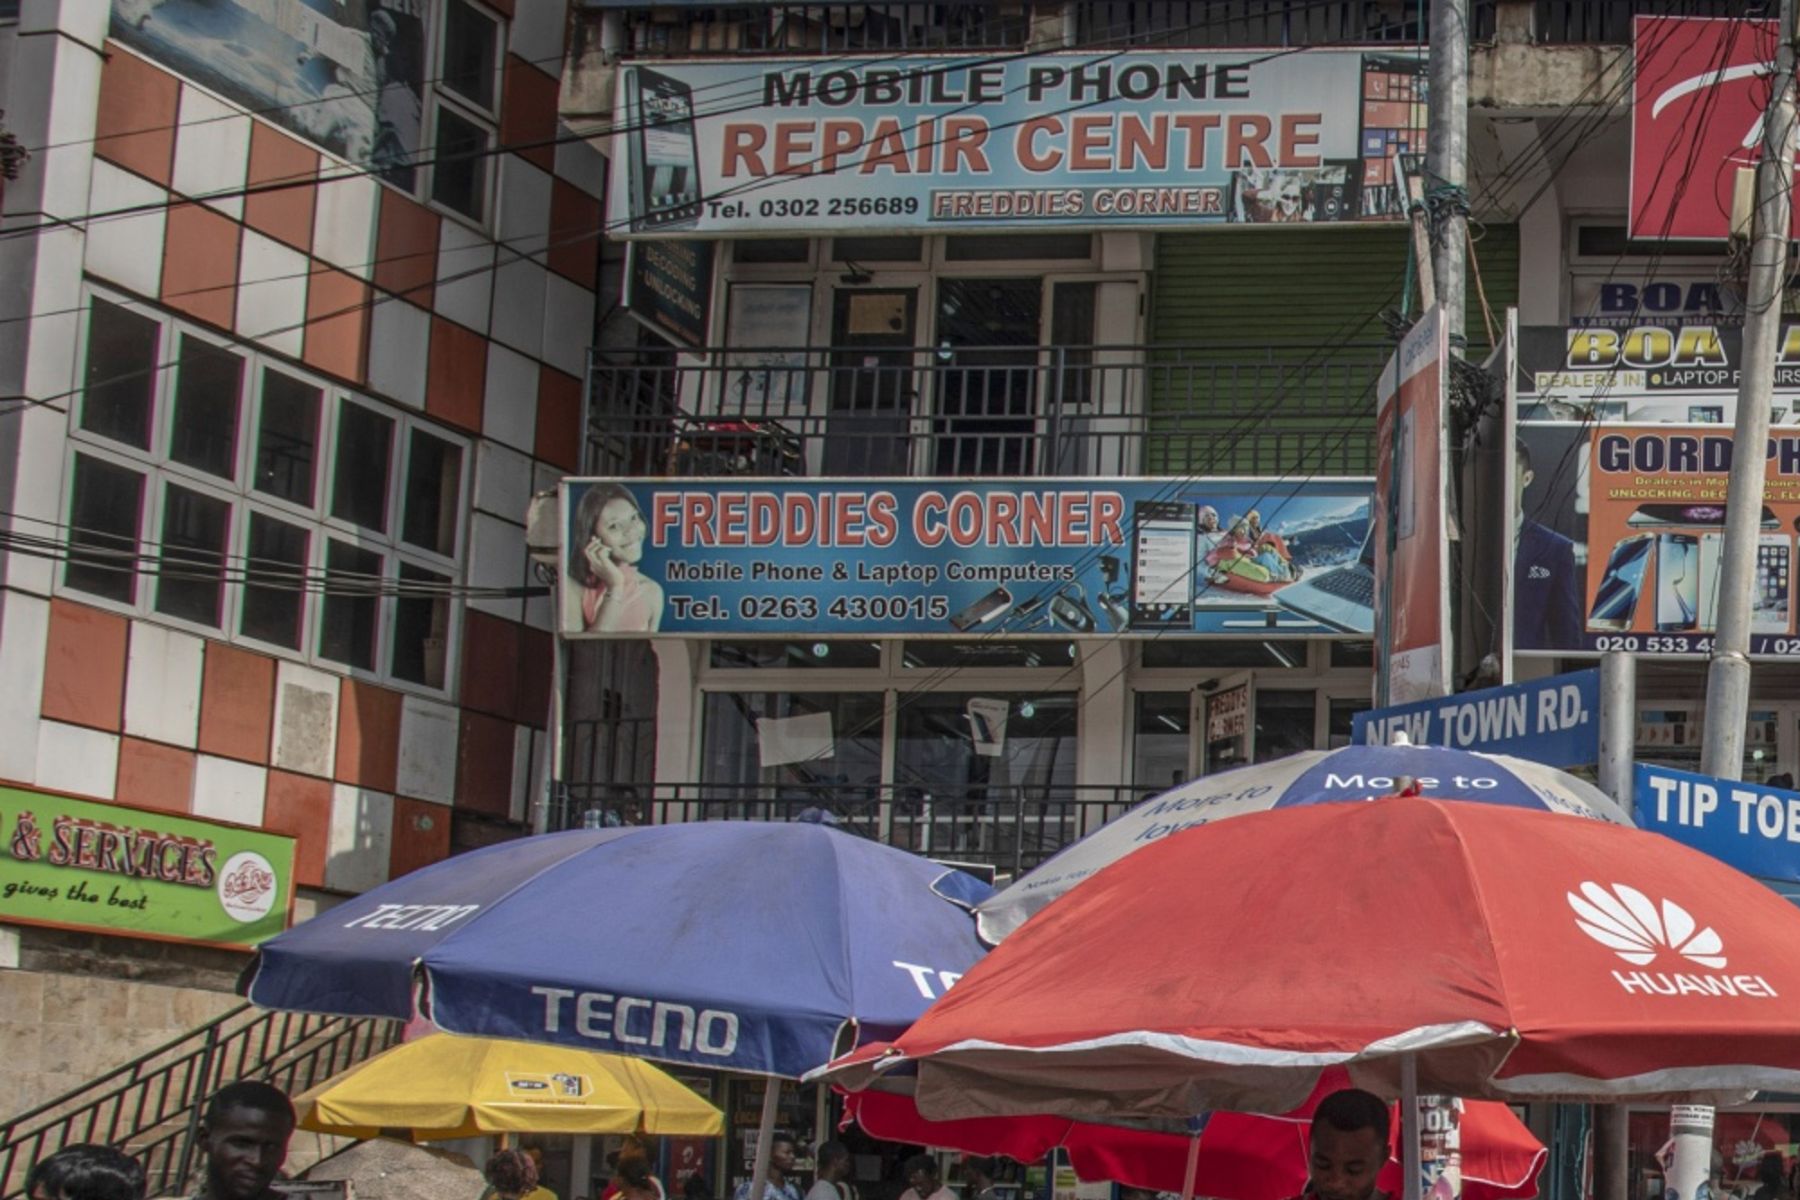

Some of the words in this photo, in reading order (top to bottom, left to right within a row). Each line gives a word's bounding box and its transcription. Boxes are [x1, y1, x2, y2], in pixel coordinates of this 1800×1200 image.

[763, 66, 1004, 107] MOBILE
[1028, 63, 1251, 101] PHONE
[721, 115, 991, 178] REPAIR
[1015, 112, 1323, 172] CENTRE
[708, 201, 750, 219] Tel.
[759, 199, 819, 217] 0302
[827, 196, 918, 216] 256689
[934, 189, 1084, 218] FREDDIES
[1091, 187, 1224, 215] CORNER
[642, 248, 698, 291] DECODING
[640, 268, 705, 322] UNLOCKING
[1600, 282, 1725, 312] BOA
[1566, 324, 1729, 369] BOA
[1535, 373, 1618, 391] DEALERS
[1662, 368, 1730, 385] LAPTOP
[1598, 434, 1732, 473] GORD
[652, 491, 899, 548] FREDDIES
[912, 489, 1127, 548] CORNER
[667, 561, 744, 582] Mobile
[751, 561, 823, 582] Phone
[832, 561, 849, 581] &
[857, 561, 938, 587] Laptop
[946, 561, 1075, 588] Computers
[670, 596, 730, 619] Tel.
[739, 596, 818, 620] 0263
[828, 596, 949, 621] 430015
[1596, 636, 1639, 652] 020
[1645, 637, 1689, 653] 533
[1438, 694, 1527, 750] TOWN
[1536, 684, 1589, 735] RD.
[1452, 774, 1498, 790] to
[1142, 793, 1233, 818] More
[1237, 785, 1274, 801] to
[1650, 774, 1718, 829] TIP
[11, 810, 42, 862] &
[49, 813, 217, 889] SERVICES
[3, 878, 59, 902] gives
[66, 880, 100, 904] the
[107, 885, 148, 911] best
[344, 903, 480, 933] TECNO
[1611, 969, 1778, 998] HUAWEI
[530, 985, 739, 1058] TECNO
